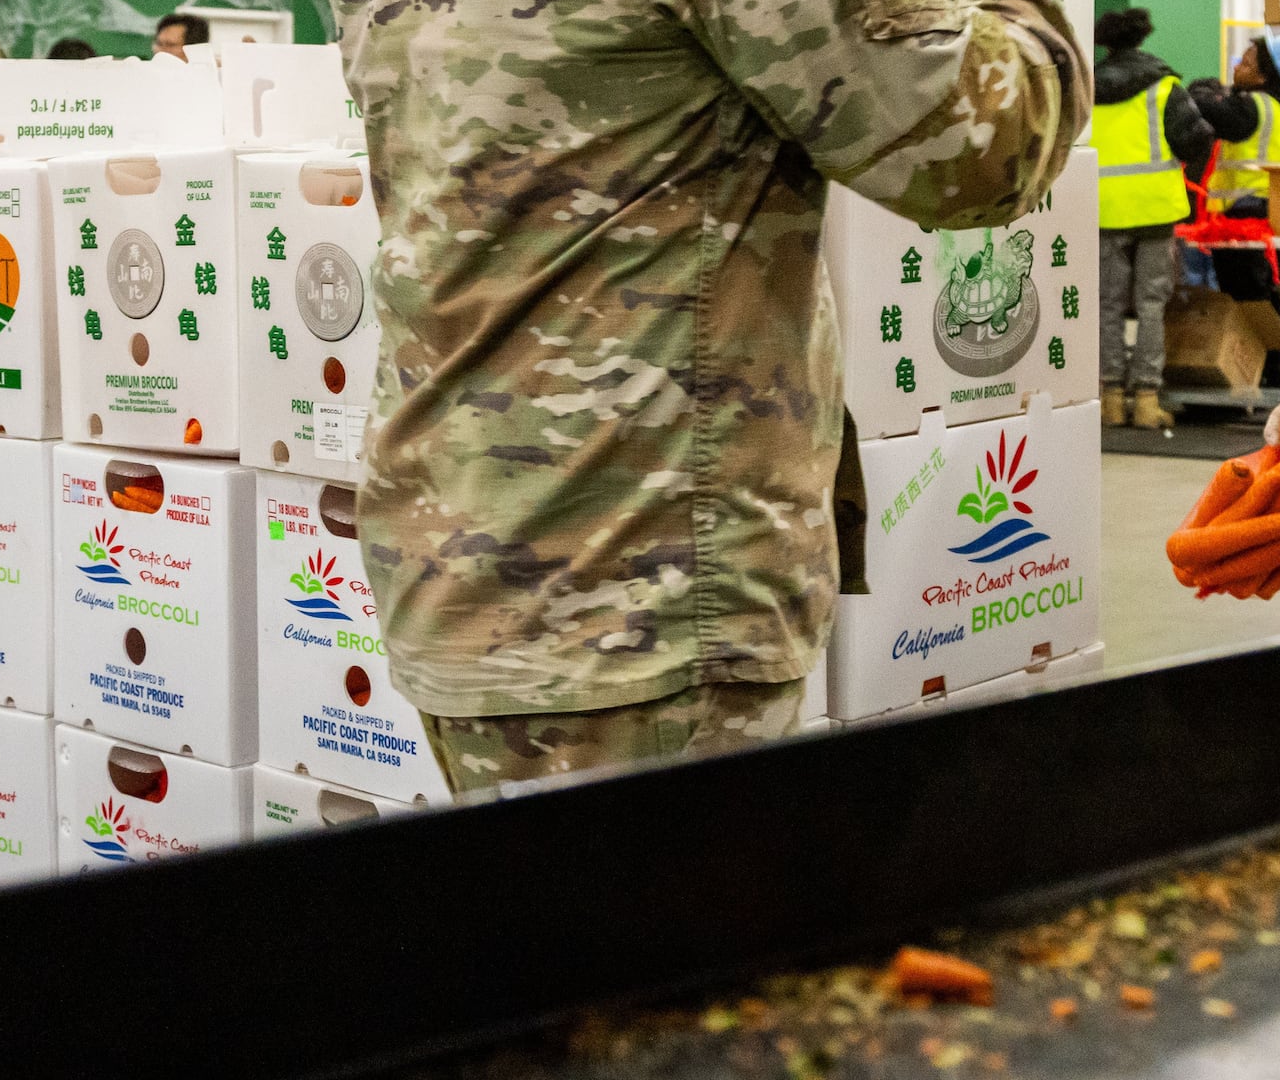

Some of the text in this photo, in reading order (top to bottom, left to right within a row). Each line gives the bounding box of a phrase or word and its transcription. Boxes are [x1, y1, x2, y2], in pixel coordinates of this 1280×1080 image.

[91, 99, 101, 112] at
[17, 123, 114, 139] Keep Refrigerated
[186, 180, 214, 190] PRODUCE
[187, 193, 195, 201] OF
[105, 375, 178, 390] PREMIUM BROCCOLI
[950, 381, 1016, 404] PREMIUM BROCCOLI
[170, 494, 200, 509] 14 BUNCHES
[880, 446, 947, 535] 优质西兰花
[166, 509, 189, 523] PRODUCE
[189, 512, 195, 524] OF
[278, 503, 309, 518] 18 BUNCHES
[298, 523, 308, 535] NET
[129, 548, 192, 571] Pacific Coast
[139, 570, 180, 589] Produce
[922, 553, 1070, 606] Pacific Coast Produce
[75, 588, 199, 626] California BROCCOLI
[892, 576, 1084, 660] California BROCCOLI
[283, 623, 333, 648] California
[105, 663, 126, 678] PACKED
[133, 670, 157, 685] SHIPPED
[158, 677, 166, 686] BY
[90, 672, 184, 708] PACIFIC COAST PRODUCE
[102, 692, 119, 705] SANTA
[142, 703, 150, 714] CA
[322, 705, 395, 732] PACKED & SHIPPED BY
[303, 715, 417, 755] PACIFIC COAST PRODUCE
[317, 737, 401, 767] SANTA MARIA, CA 93458
[135, 828, 168, 849] Pacific
